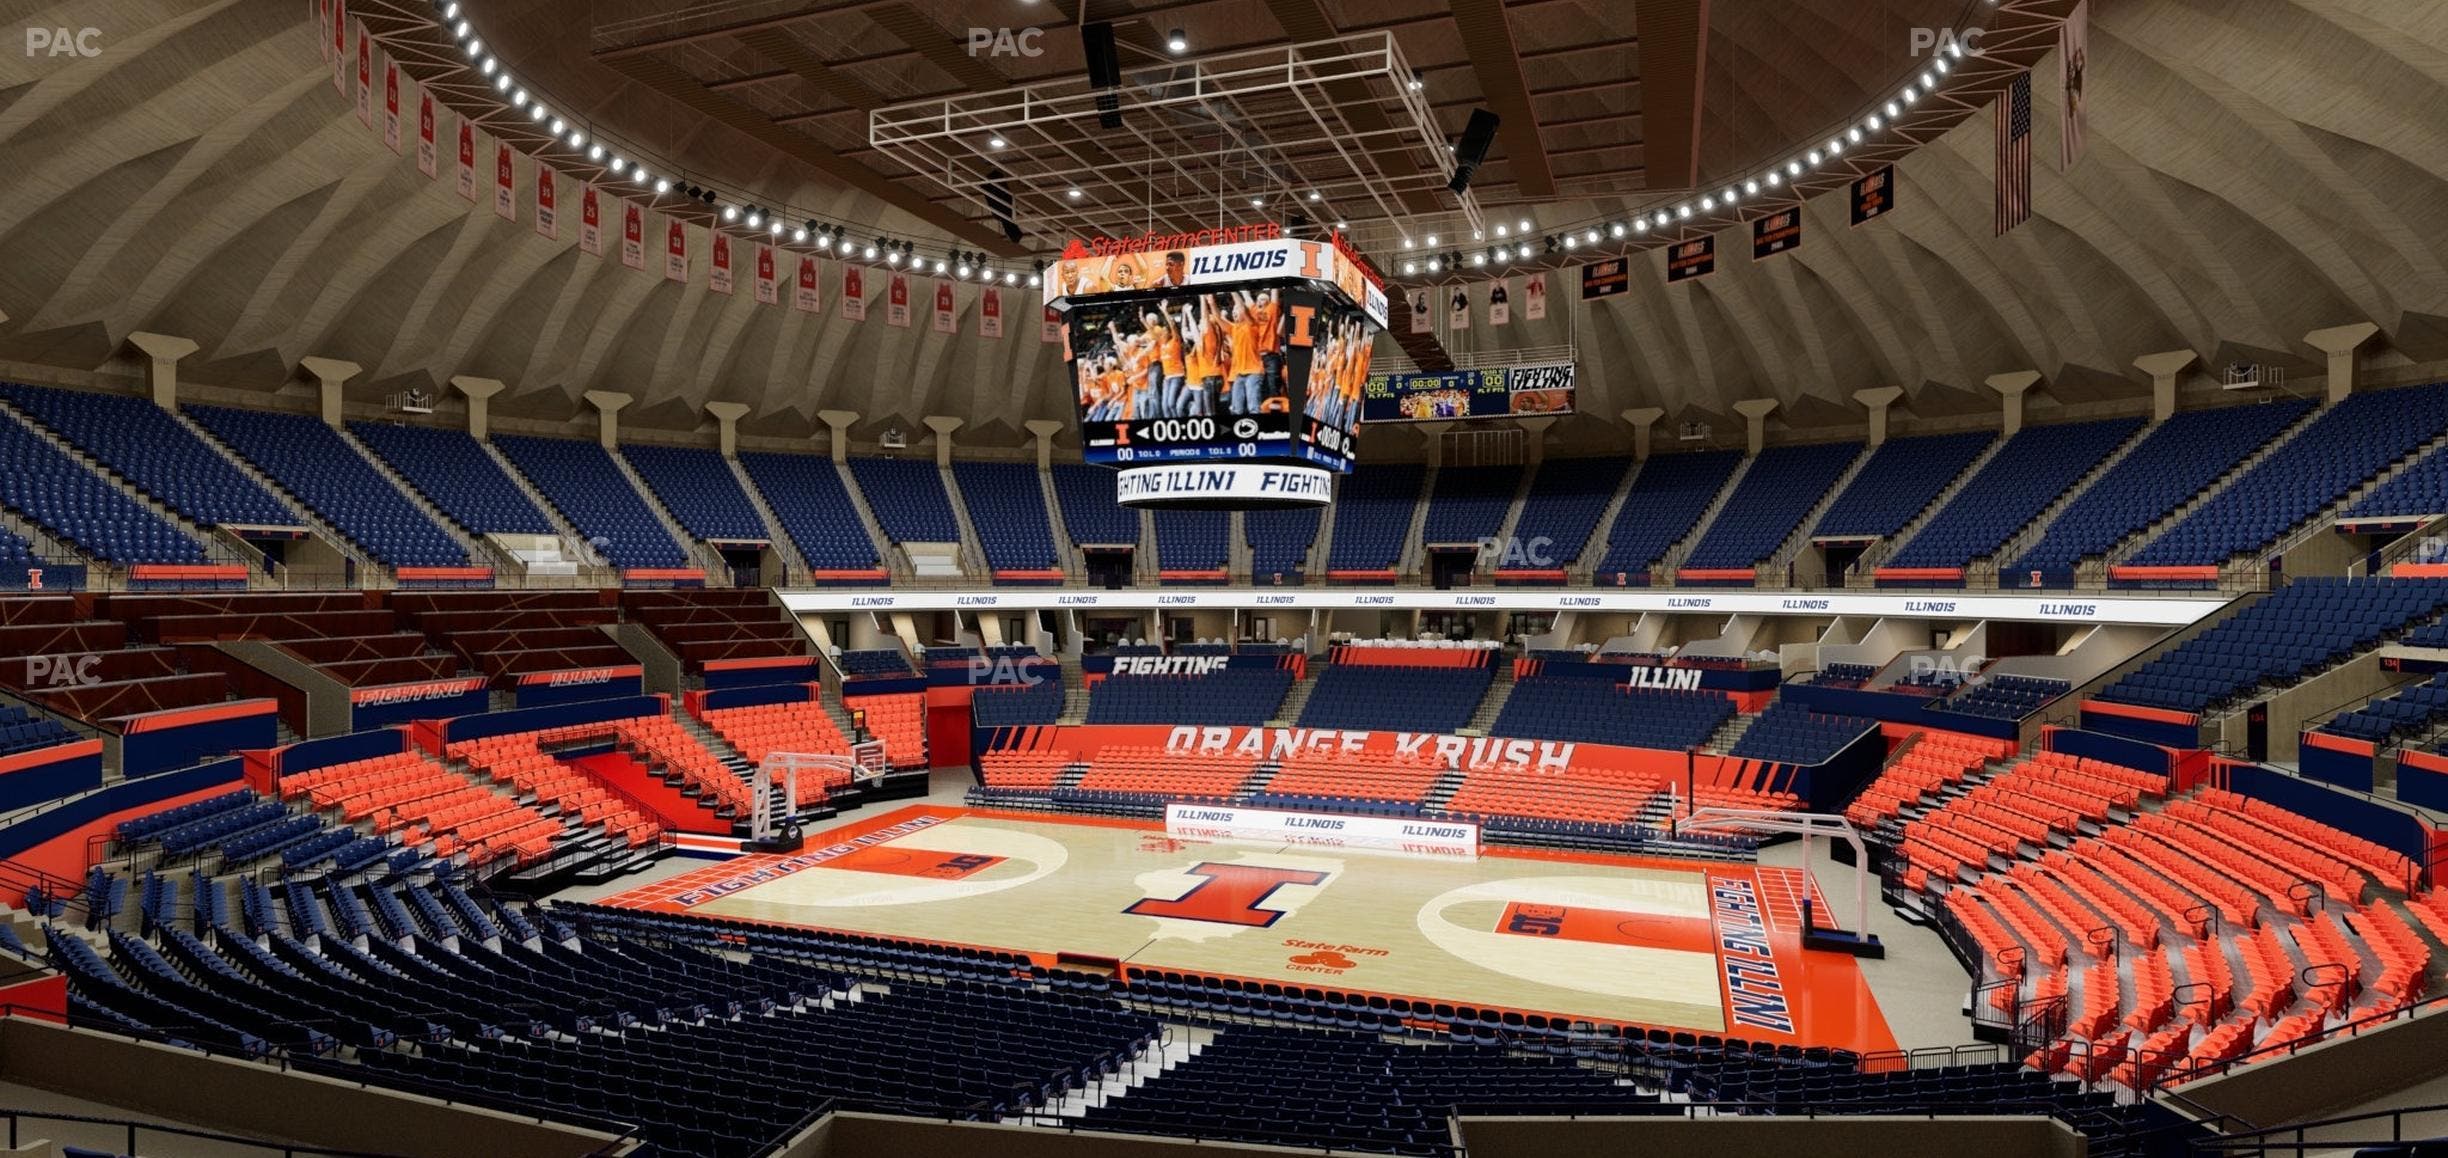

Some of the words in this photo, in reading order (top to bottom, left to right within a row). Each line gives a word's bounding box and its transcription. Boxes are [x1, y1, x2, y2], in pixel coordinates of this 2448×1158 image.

[1192, 249, 1288, 275] ILLINOIS
[1512, 365, 1572, 381] FIGHTING
[1511, 375, 1574, 391] ILLINI
[1152, 418, 1215, 442] 00:00
[1117, 447, 1134, 461] 00
[1238, 443, 1257, 457] 00
[1166, 471, 1236, 492] ILLINI
[851, 597, 894, 606] ILLINOIS
[957, 596, 997, 605] ILLINOIS
[1058, 596, 1098, 604] ILLINOIS
[1158, 596, 1196, 604] ILLINOIS
[1256, 596, 1295, 604] ILLINOIS
[1355, 596, 1394, 604] ILLINOIS
[1456, 597, 1496, 605] ILLINOIS
[1559, 597, 1601, 606] ILLINOIS
[1667, 598, 1712, 607] ILLINOIS
[1782, 600, 1829, 610] ILLINOIS
[1905, 602, 1956, 612] ILLINOIS
[2039, 604, 2096, 616] ILLINOIS
[1112, 656, 1229, 675] FIGHTING
[1629, 666, 1703, 691] ILLINI
[358, 680, 468, 707] FIGHTING
[1166, 725, 1370, 760] ORANGE
[1393, 732, 1575, 774] KRUSH
[1176, 810, 1234, 822] ILLINOIS
[1284, 817, 1346, 830] ILLINOIS
[1402, 825, 1467, 839] ILLINOIS
[669, 842, 855, 905] FIGHTING
[852, 815, 944, 847] ILLINI
[1711, 875, 1773, 958] FIGHTING
[1281, 938, 1336, 952] State
[1333, 943, 1389, 957] Farm
[1285, 963, 1344, 976] CENTER
[1723, 954, 1796, 1035] ILLINI
